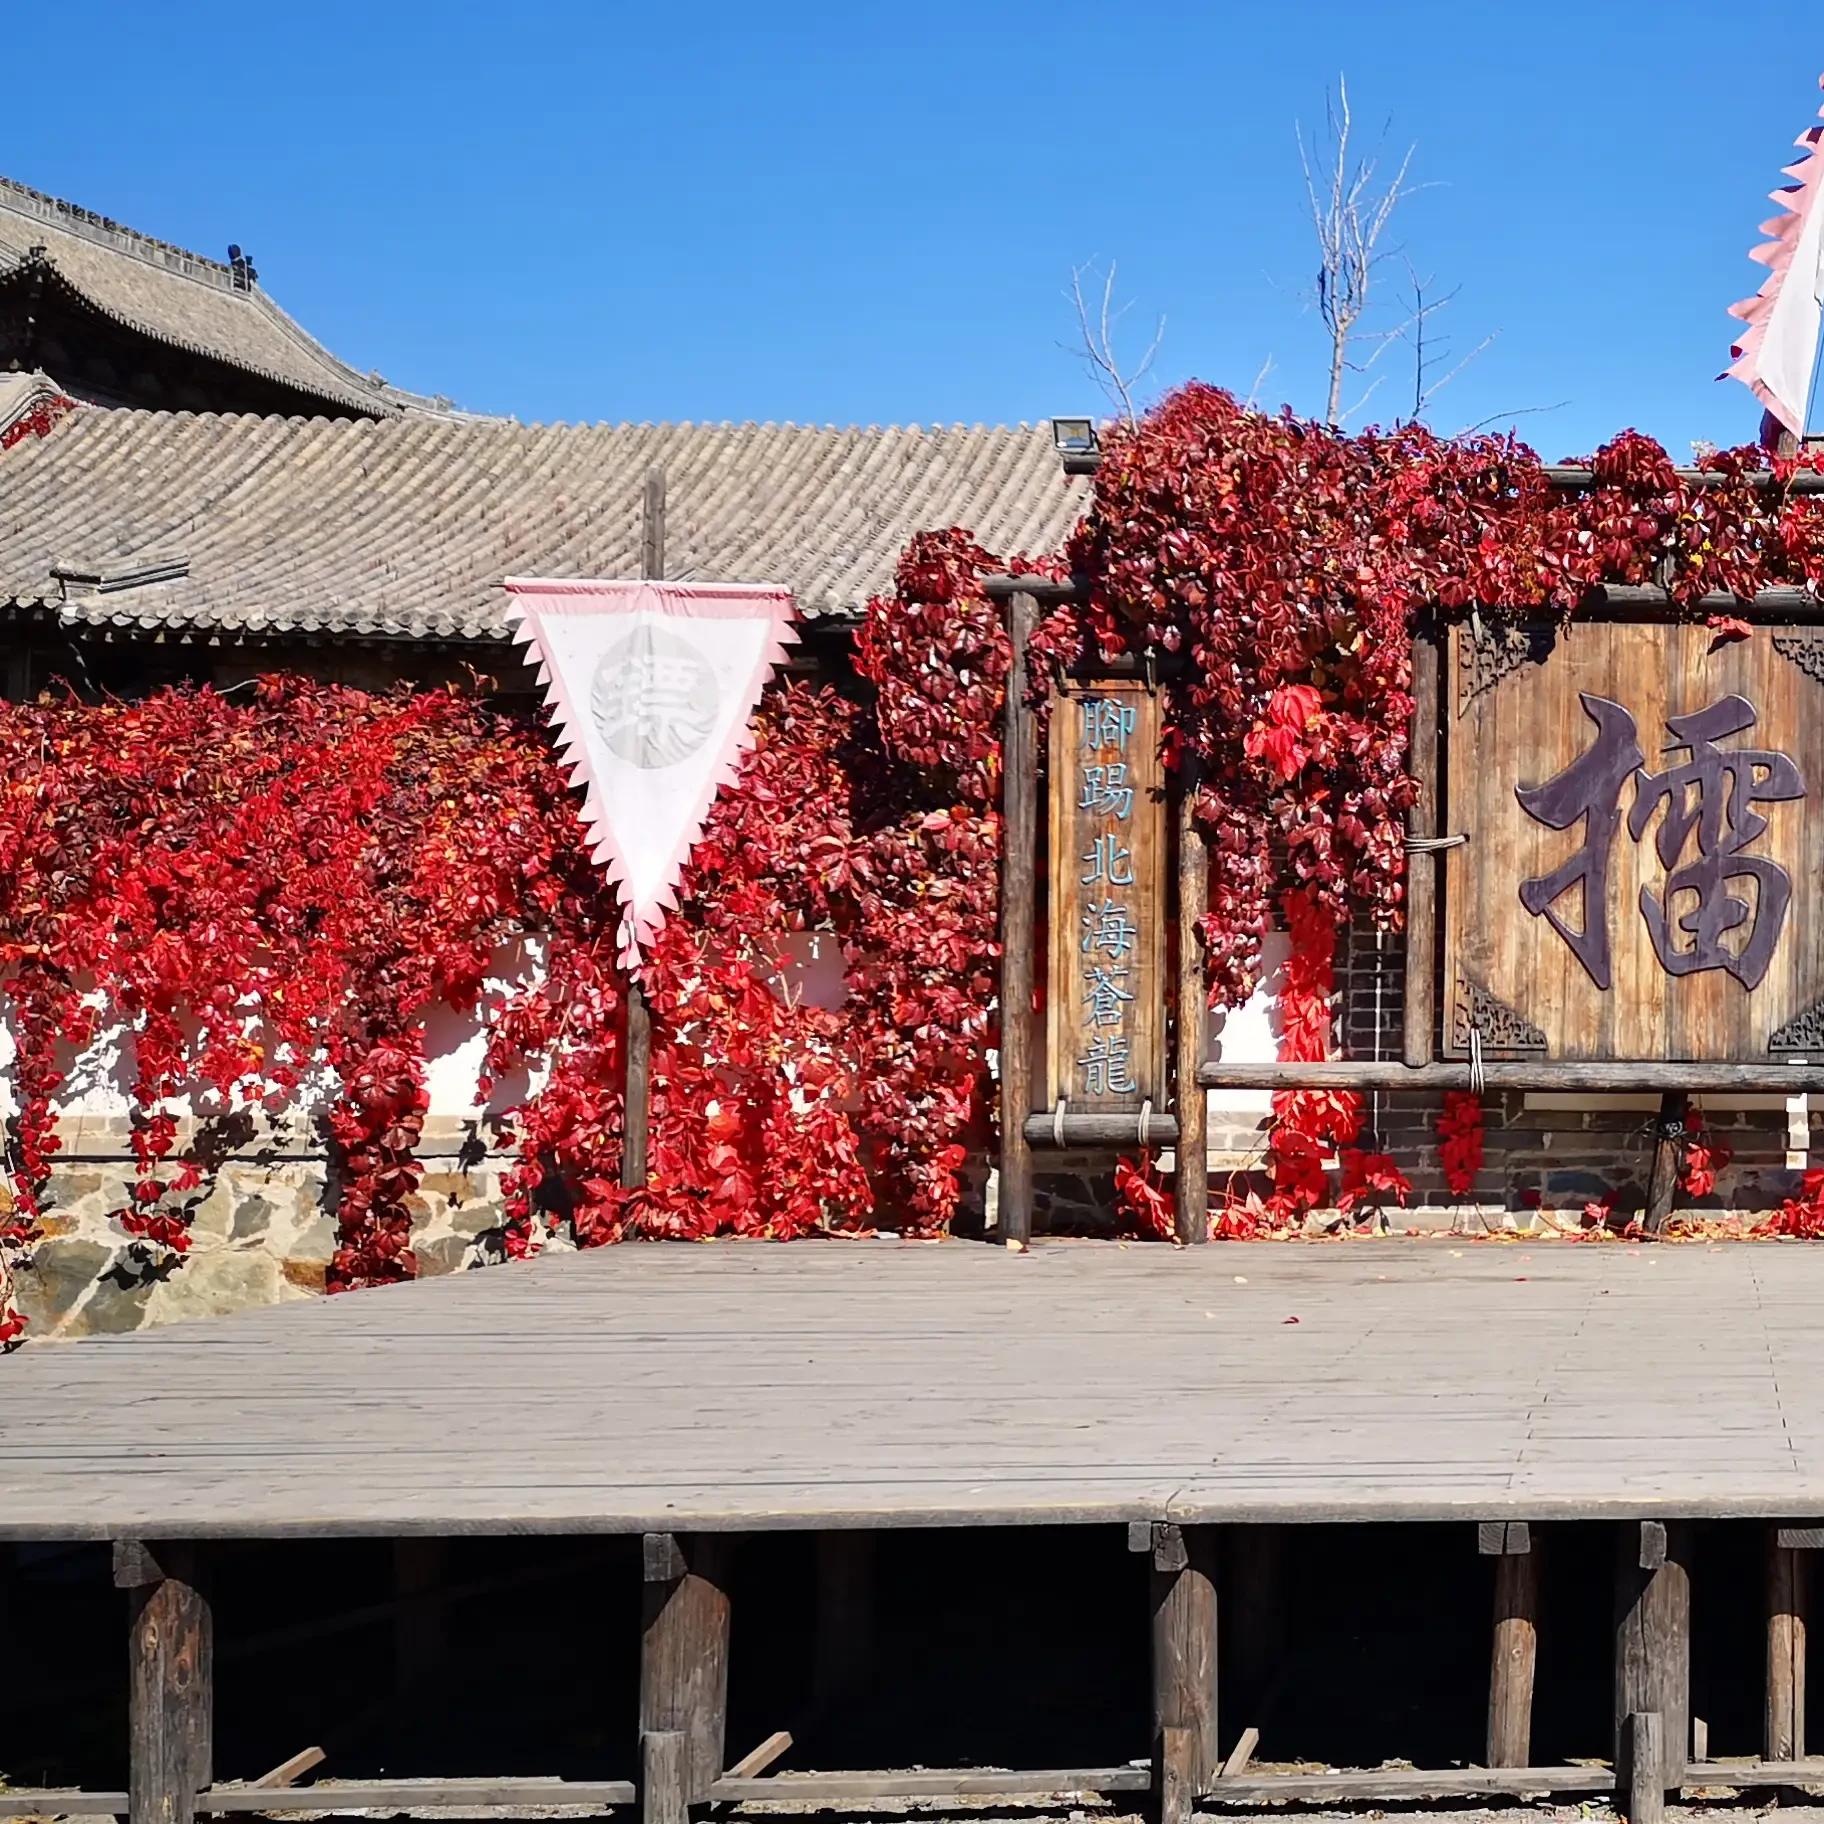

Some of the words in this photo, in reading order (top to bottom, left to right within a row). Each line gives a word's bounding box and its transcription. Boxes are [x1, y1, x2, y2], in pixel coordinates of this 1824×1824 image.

[1077, 698, 1137, 1096] 腳踢北海蒼龍
[1515, 691, 1806, 992] 擂
